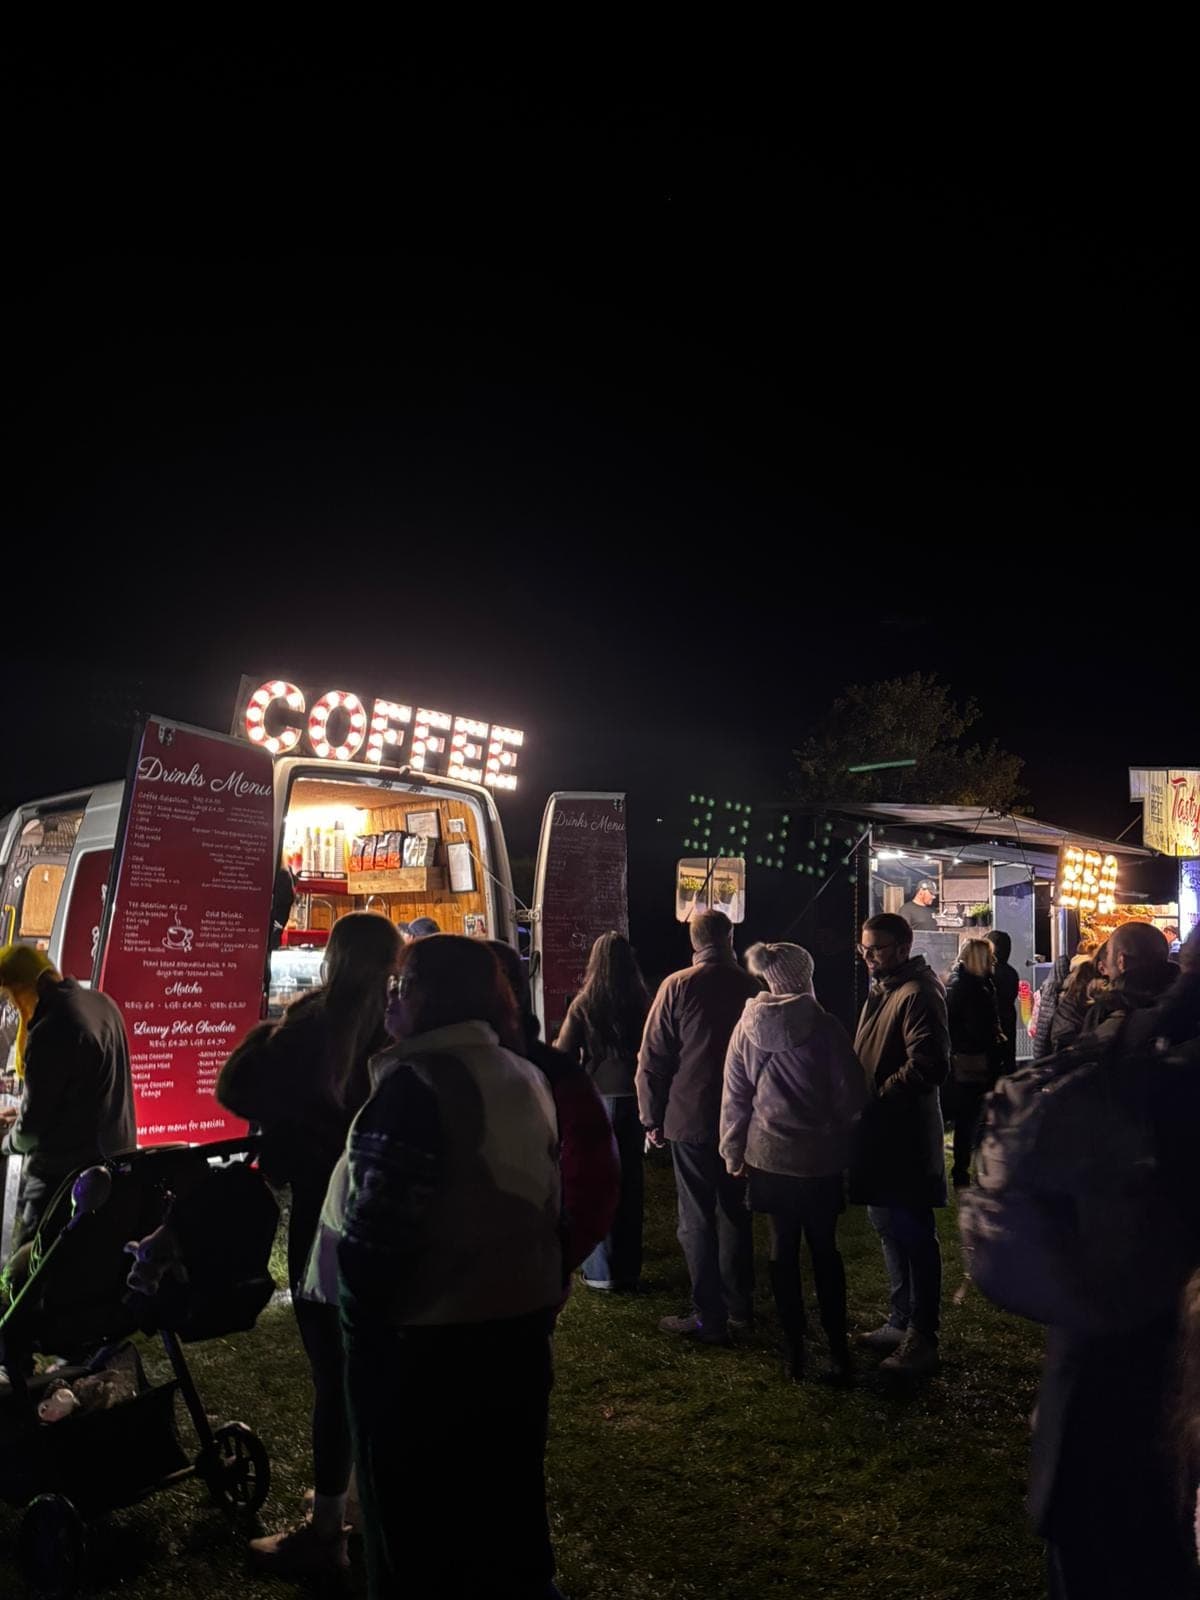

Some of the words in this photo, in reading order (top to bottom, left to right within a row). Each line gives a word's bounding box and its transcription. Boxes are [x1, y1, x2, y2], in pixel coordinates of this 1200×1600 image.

[246, 679, 525, 791] COFFEE
[138, 756, 206, 787] Drinks
[210, 771, 273, 798] Menu
[554, 810, 588, 829] Drinks
[590, 815, 625, 833] Menu
[165, 980, 203, 997] Matcha
[133, 1020, 170, 1039] Luxury
[171, 1019, 194, 1035] Hot
[195, 1019, 237, 1035] Chocolate
[188, 1118, 200, 1132] for
